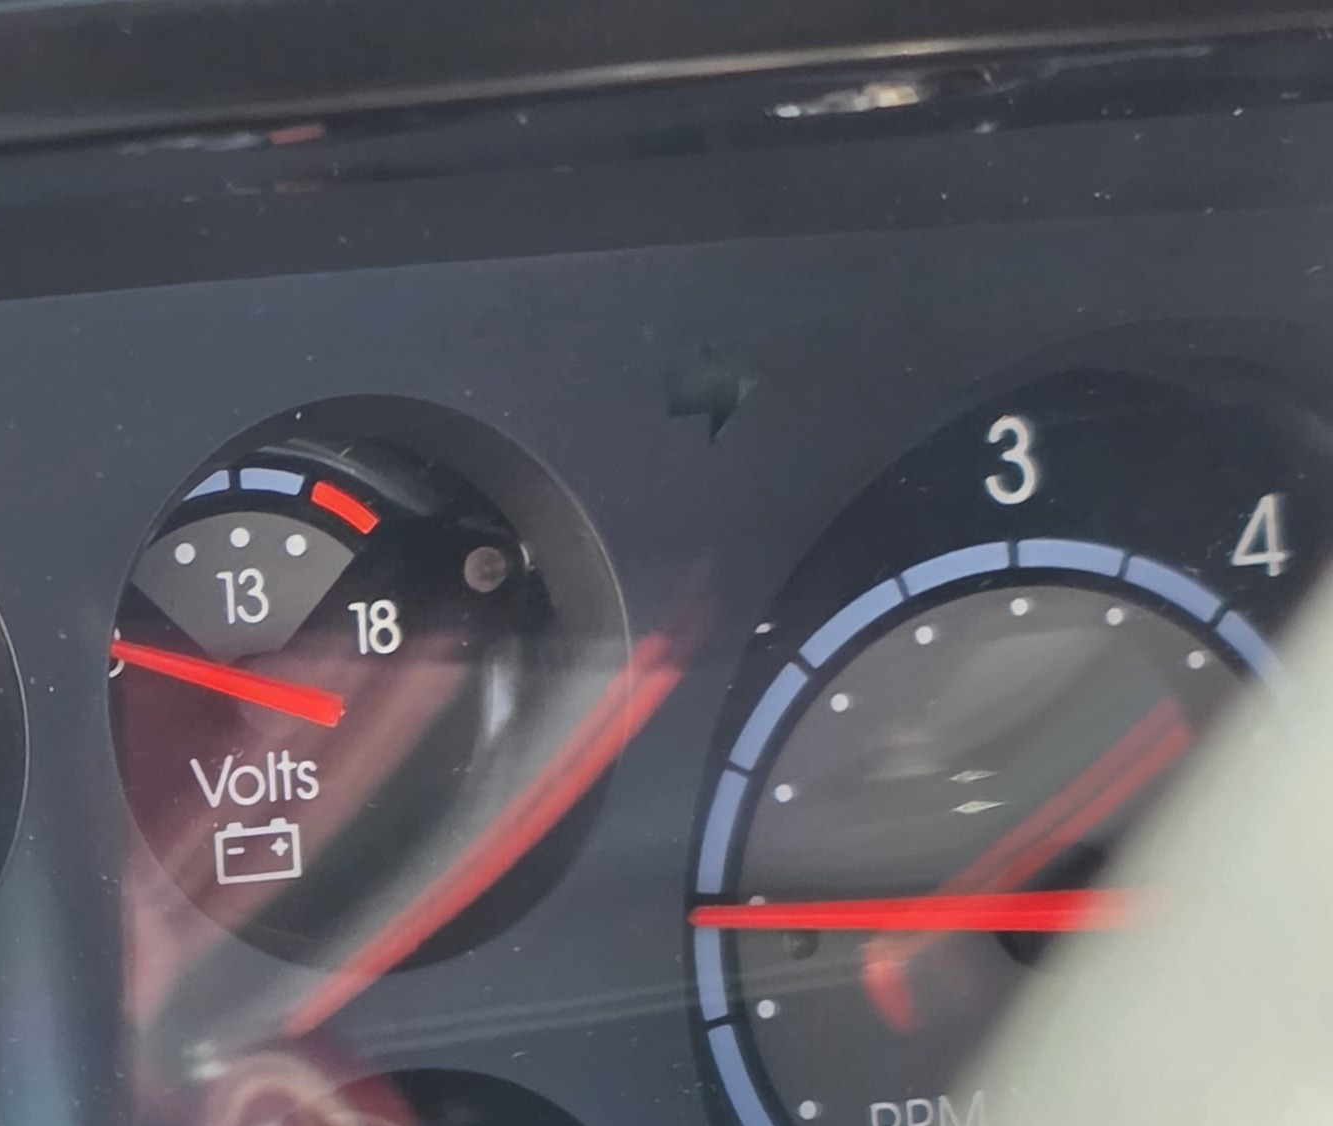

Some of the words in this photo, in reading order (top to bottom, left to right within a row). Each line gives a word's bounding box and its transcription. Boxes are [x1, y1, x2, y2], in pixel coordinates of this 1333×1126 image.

[984, 414, 1040, 505] 3
[1230, 493, 1290, 577] 4
[216, 567, 271, 625] 13
[347, 599, 403, 656] 18
[189, 749, 321, 809] Volts
